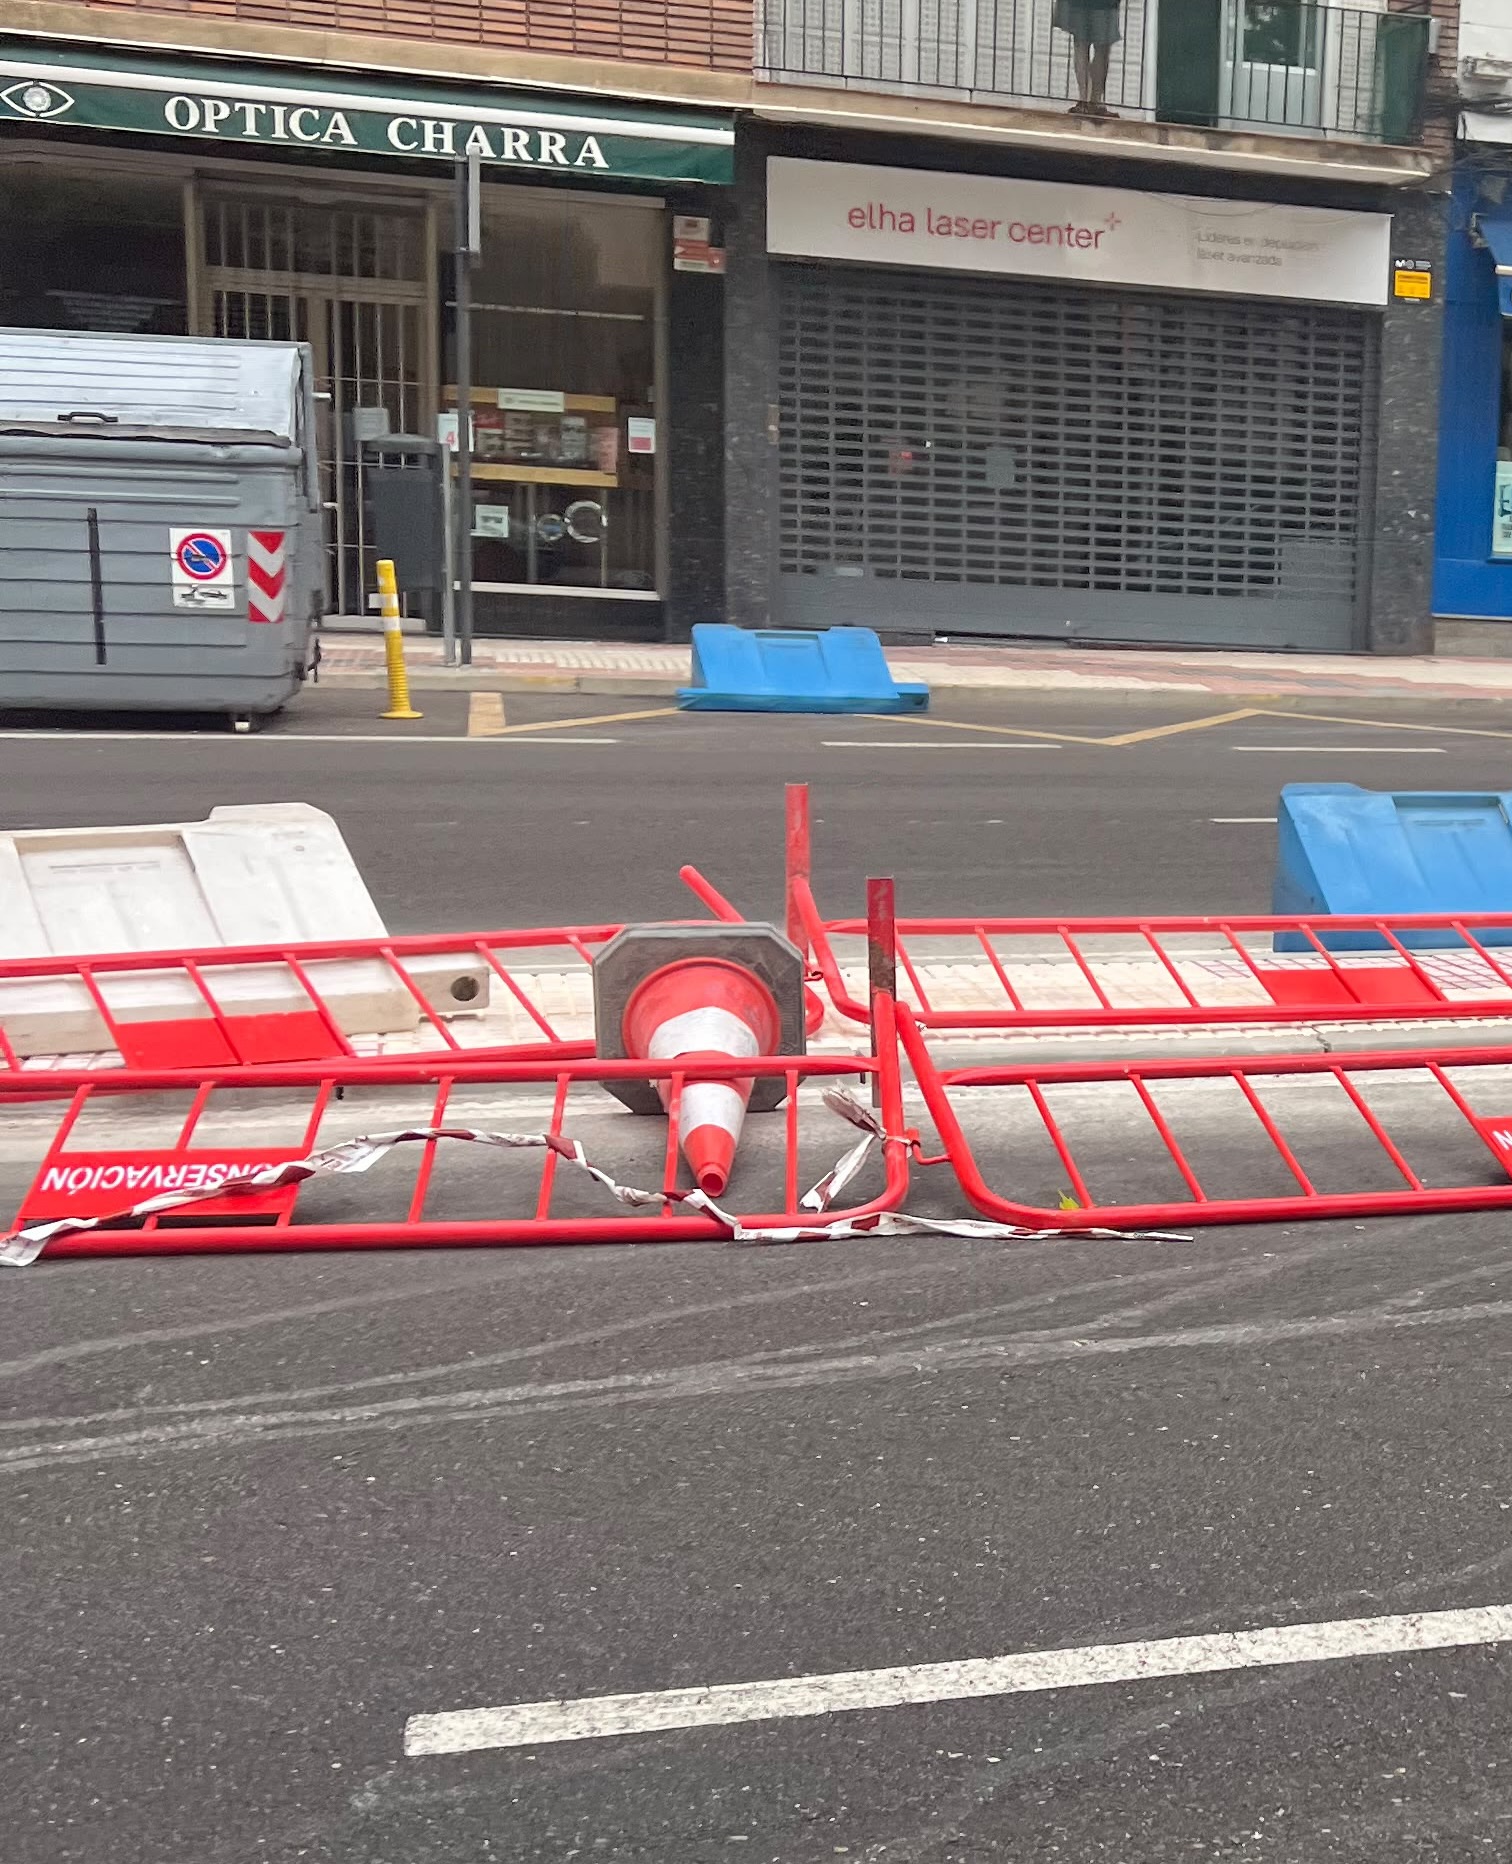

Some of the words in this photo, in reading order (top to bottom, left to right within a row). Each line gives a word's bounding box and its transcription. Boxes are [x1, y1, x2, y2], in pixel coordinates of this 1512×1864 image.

[164, 95, 358, 145] OPTICA
[386, 117, 610, 169] CHARRA
[848, 203, 915, 233] elha
[926, 207, 1002, 240] laser
[1008, 222, 1107, 249] center
[41, 1163, 276, 1196] NSERVACIÓN
